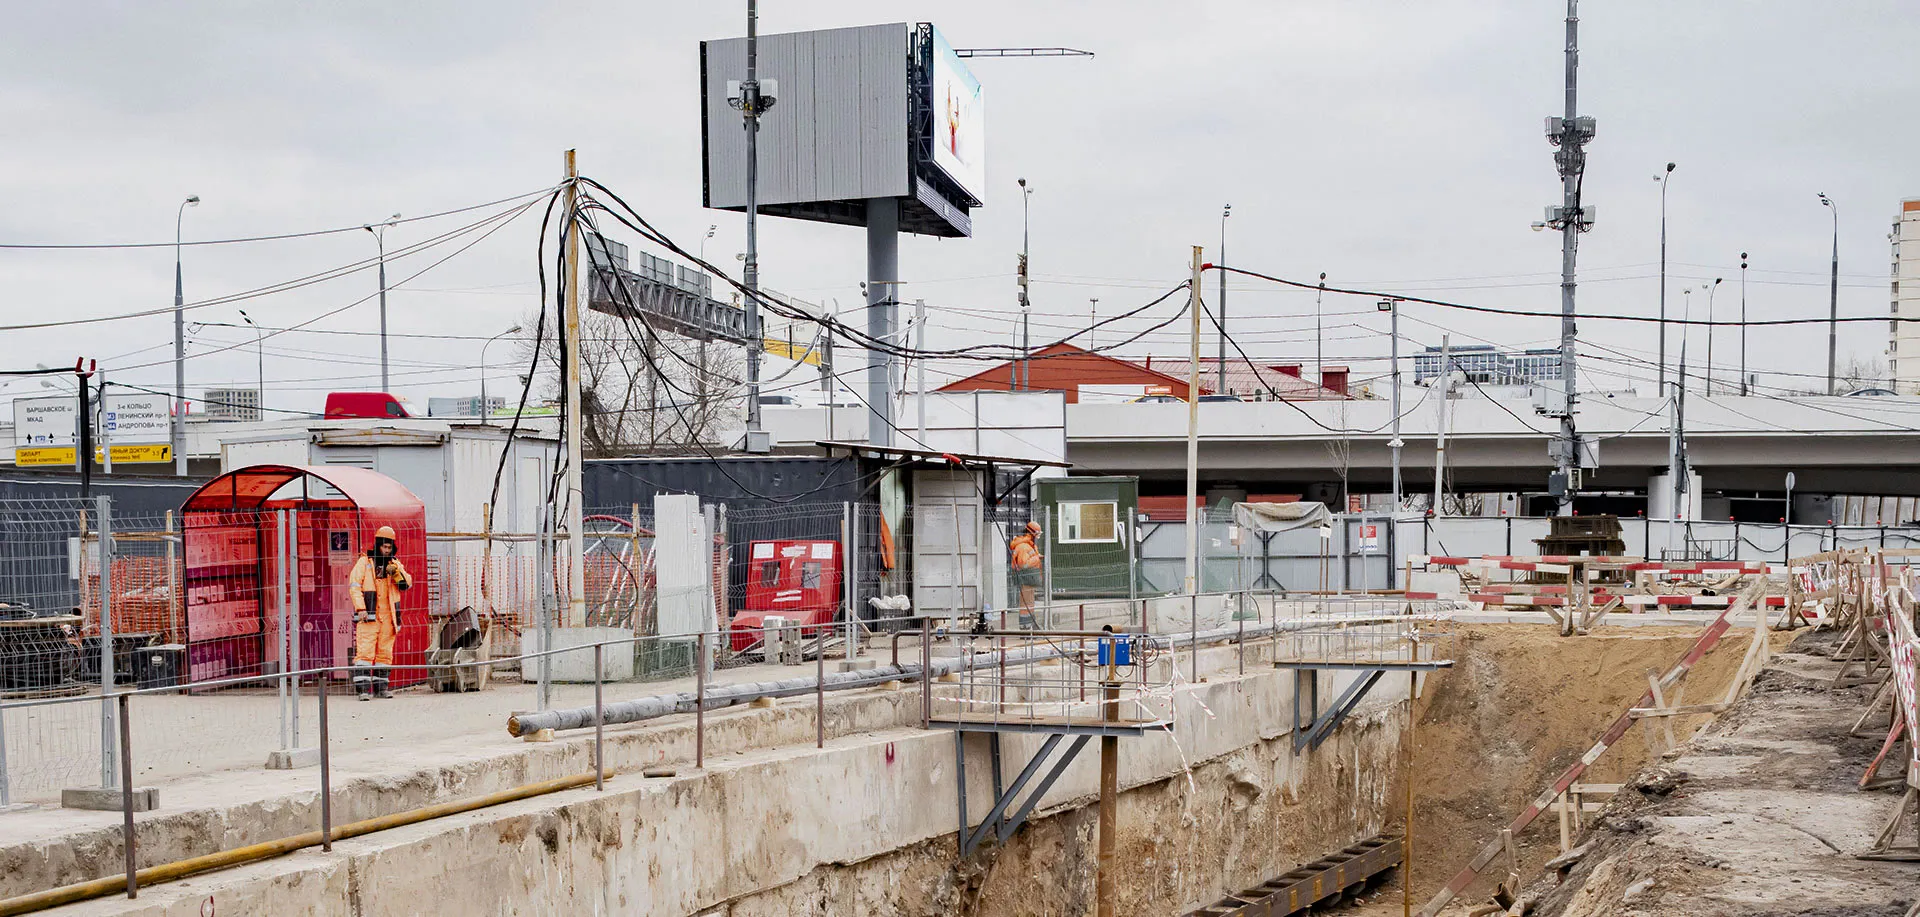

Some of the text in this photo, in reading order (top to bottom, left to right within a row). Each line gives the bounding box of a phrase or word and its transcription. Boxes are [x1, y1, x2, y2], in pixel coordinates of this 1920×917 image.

[117, 412, 154, 420] ЛЕНИНСКИЙ
[118, 422, 155, 430] АНДРОПОВА
[129, 447, 150, 455] ДОКТОР
